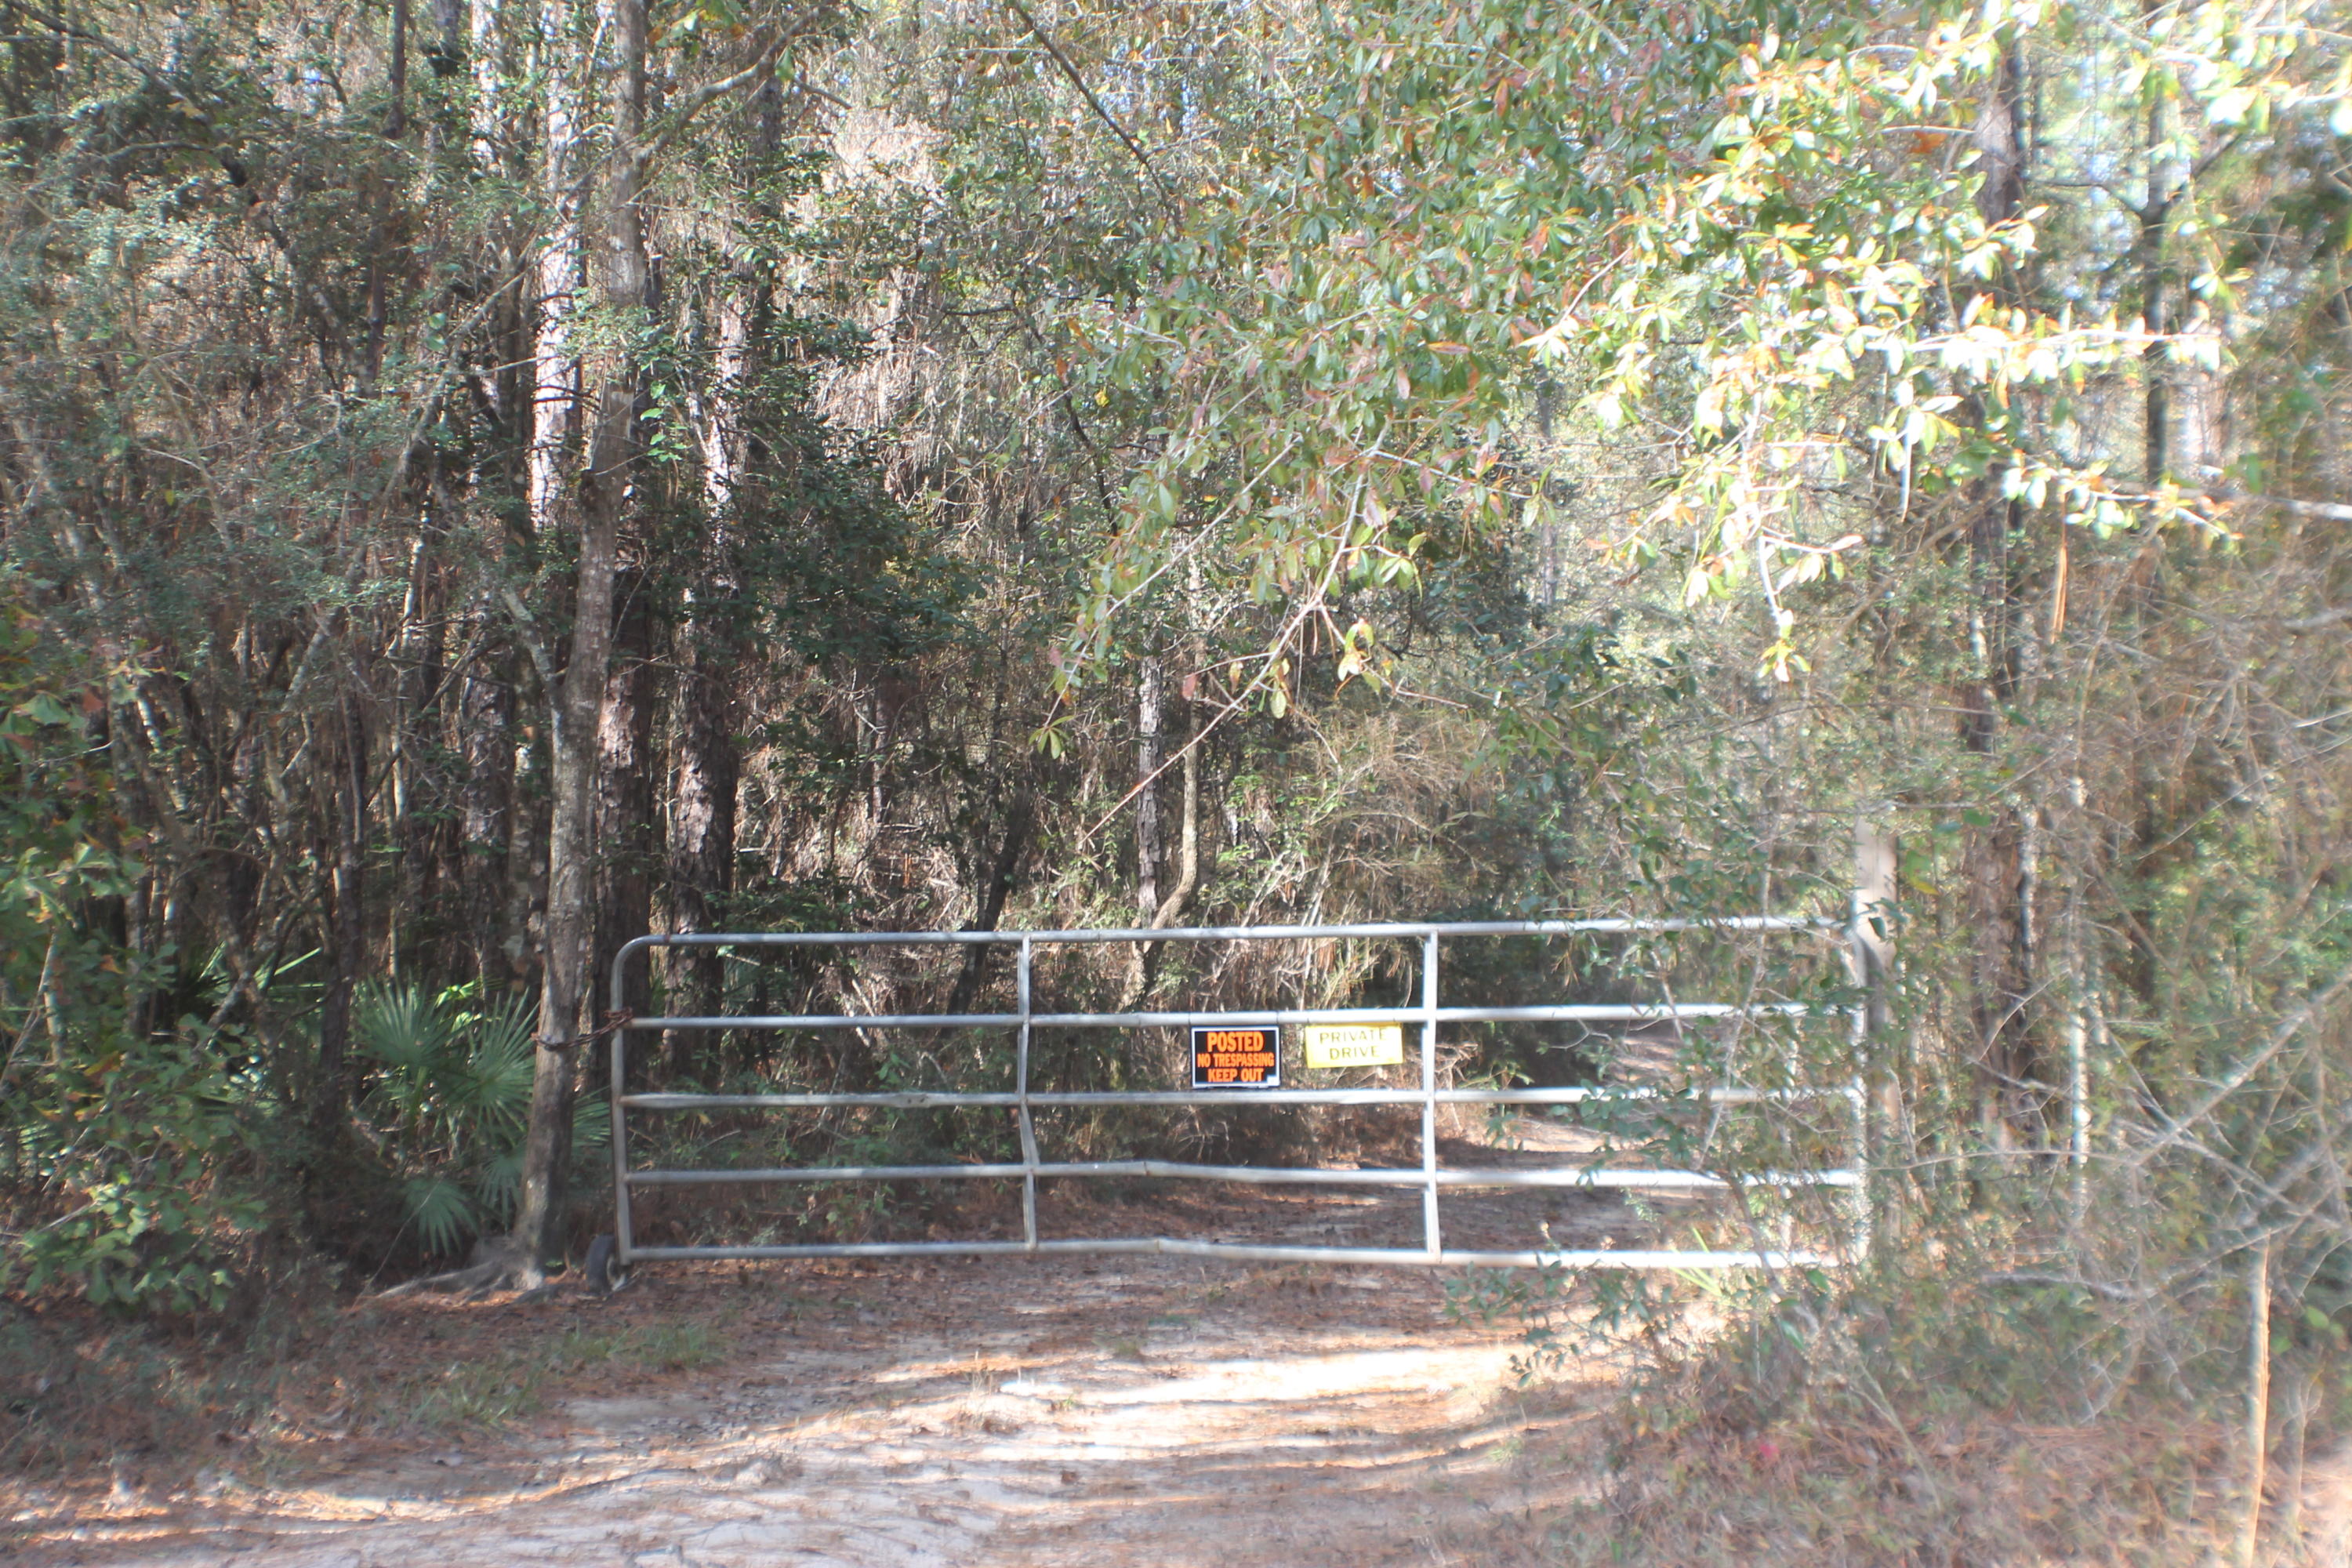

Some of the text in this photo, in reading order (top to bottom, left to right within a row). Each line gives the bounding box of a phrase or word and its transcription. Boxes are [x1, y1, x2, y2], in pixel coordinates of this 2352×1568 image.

[1207, 1031, 1263, 1052] POSTED
[1319, 1029, 1386, 1044] PRIVATE
[1197, 1052, 1275, 1068] NO TRESPASSING
[1330, 1046, 1379, 1060] DRIVE
[1208, 1068, 1264, 1082] KEEP OUT
